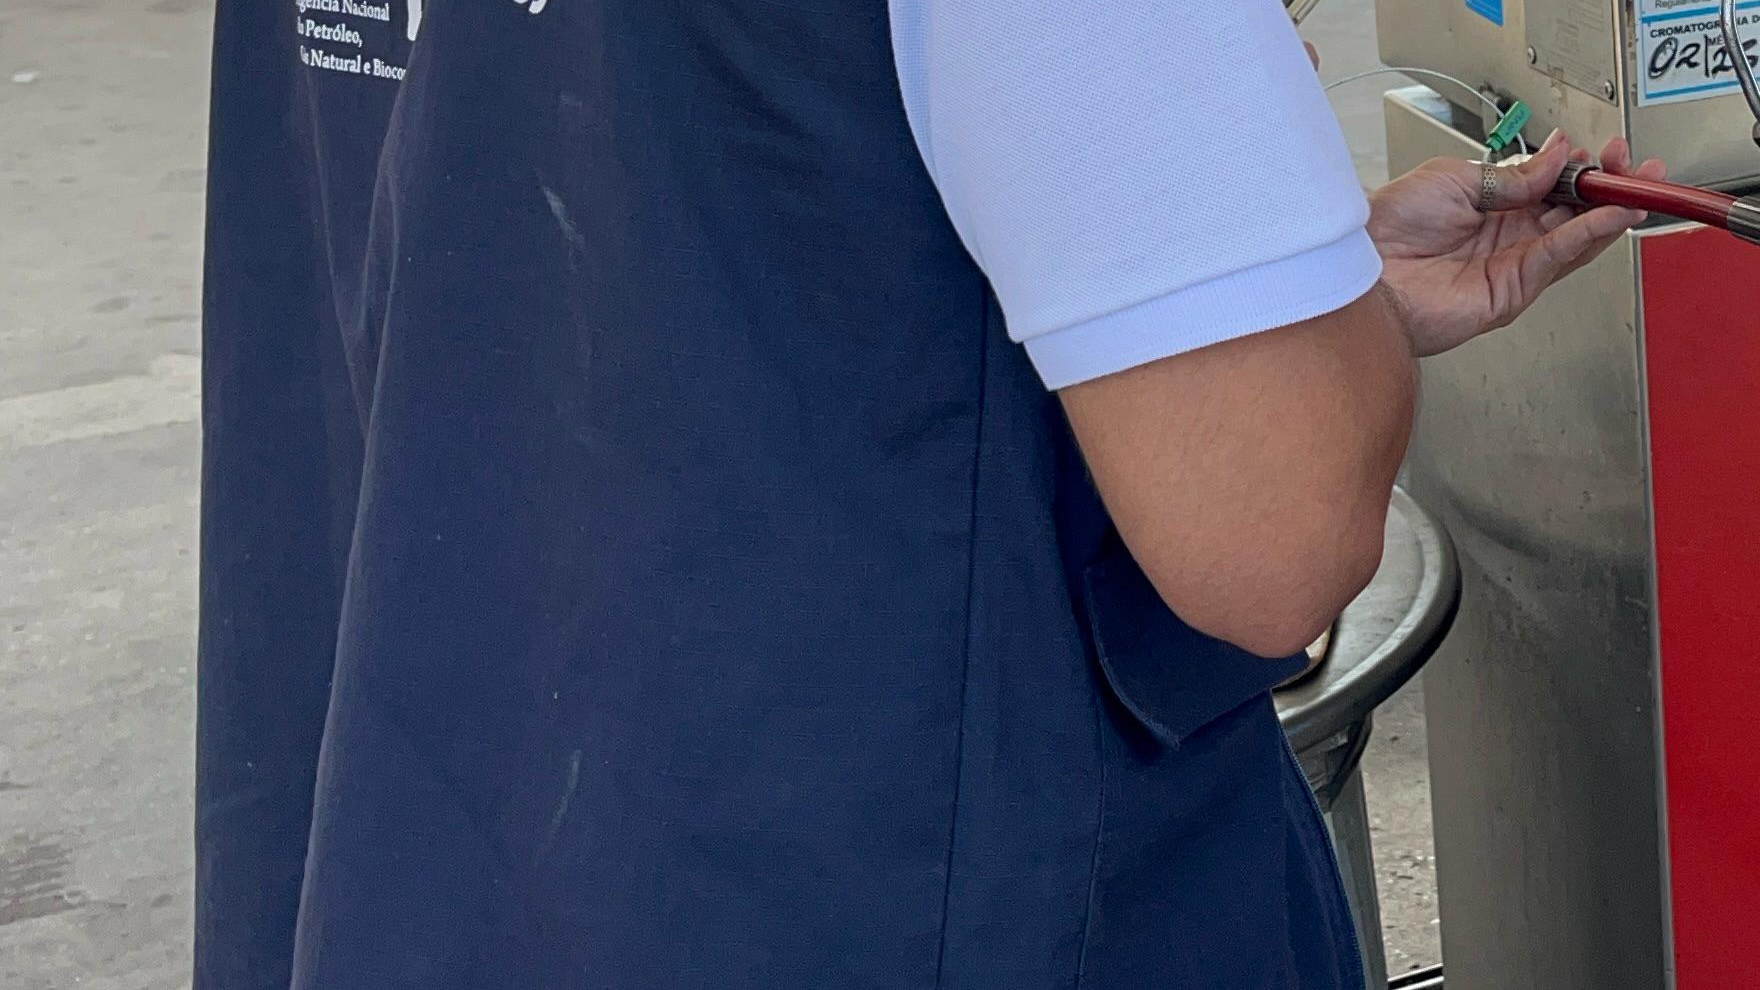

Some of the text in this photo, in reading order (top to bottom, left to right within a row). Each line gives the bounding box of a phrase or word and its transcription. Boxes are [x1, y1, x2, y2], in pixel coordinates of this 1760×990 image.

[305, 19, 363, 48] Petróleo,
[310, 48, 361, 73] Natural
[363, 61, 371, 75] e
